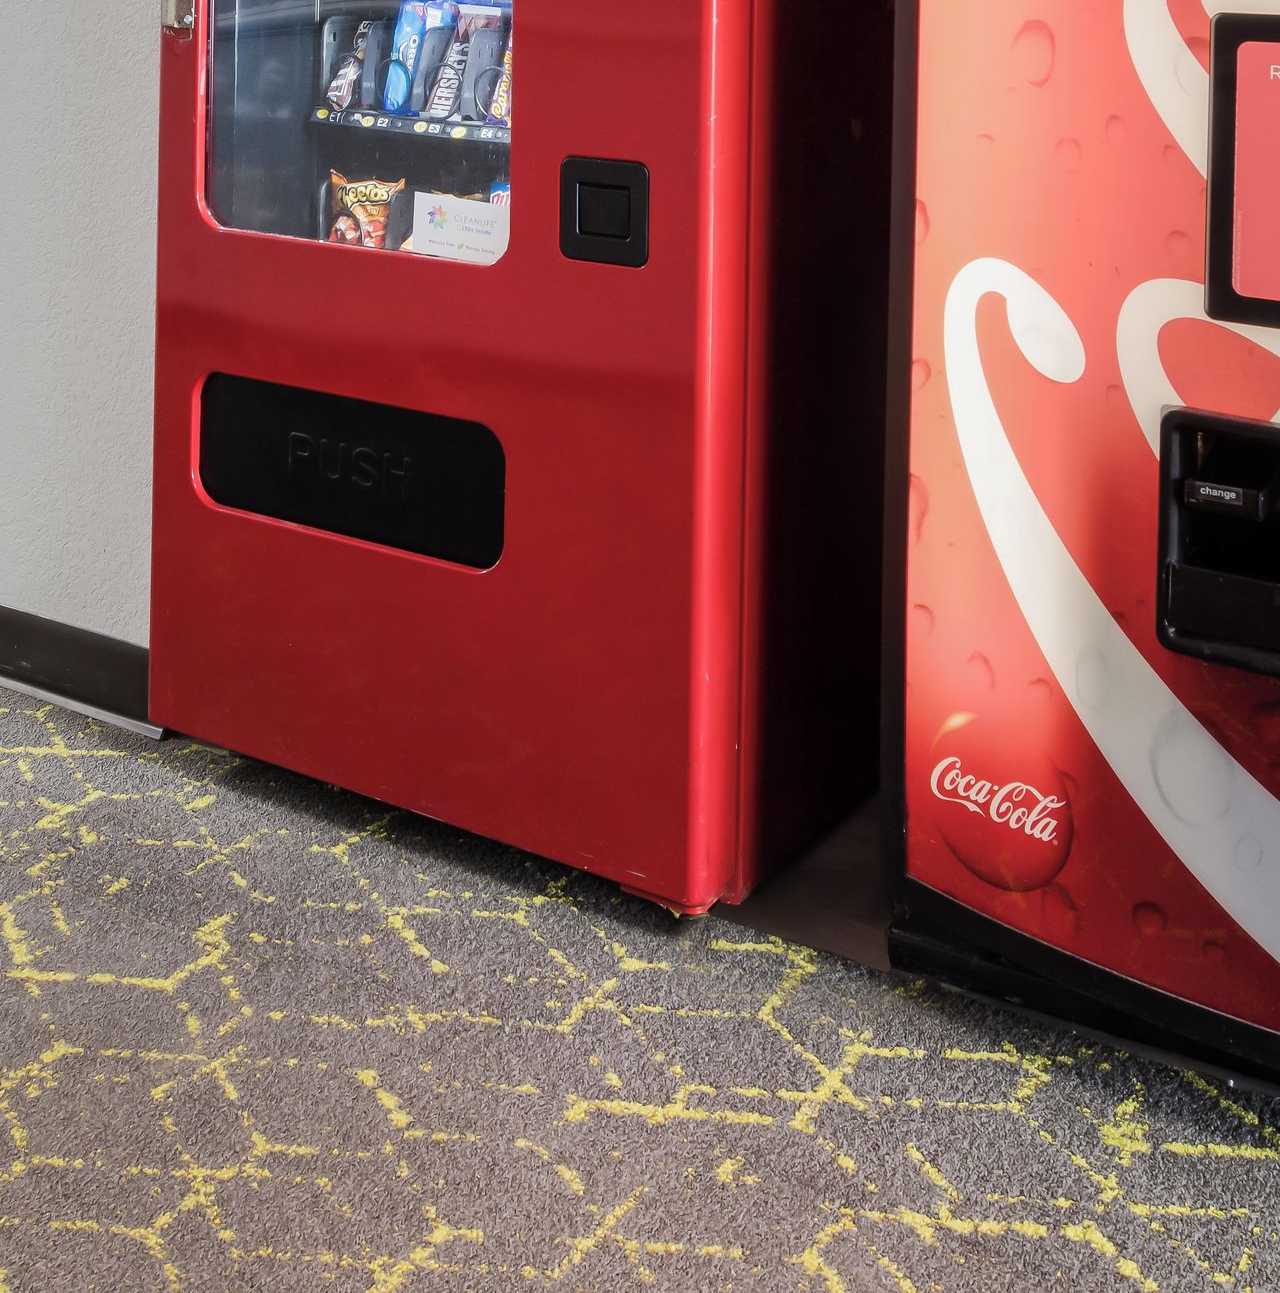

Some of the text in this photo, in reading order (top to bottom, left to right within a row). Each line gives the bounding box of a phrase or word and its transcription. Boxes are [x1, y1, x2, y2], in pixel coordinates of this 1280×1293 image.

[430, 42, 469, 118] HERSHEY'S
[377, 118, 493, 138] E2 E3 E4
[288, 431, 412, 499] PUSH
[1200, 486, 1236, 499] change
[930, 756, 1067, 842] Coca-Cola
